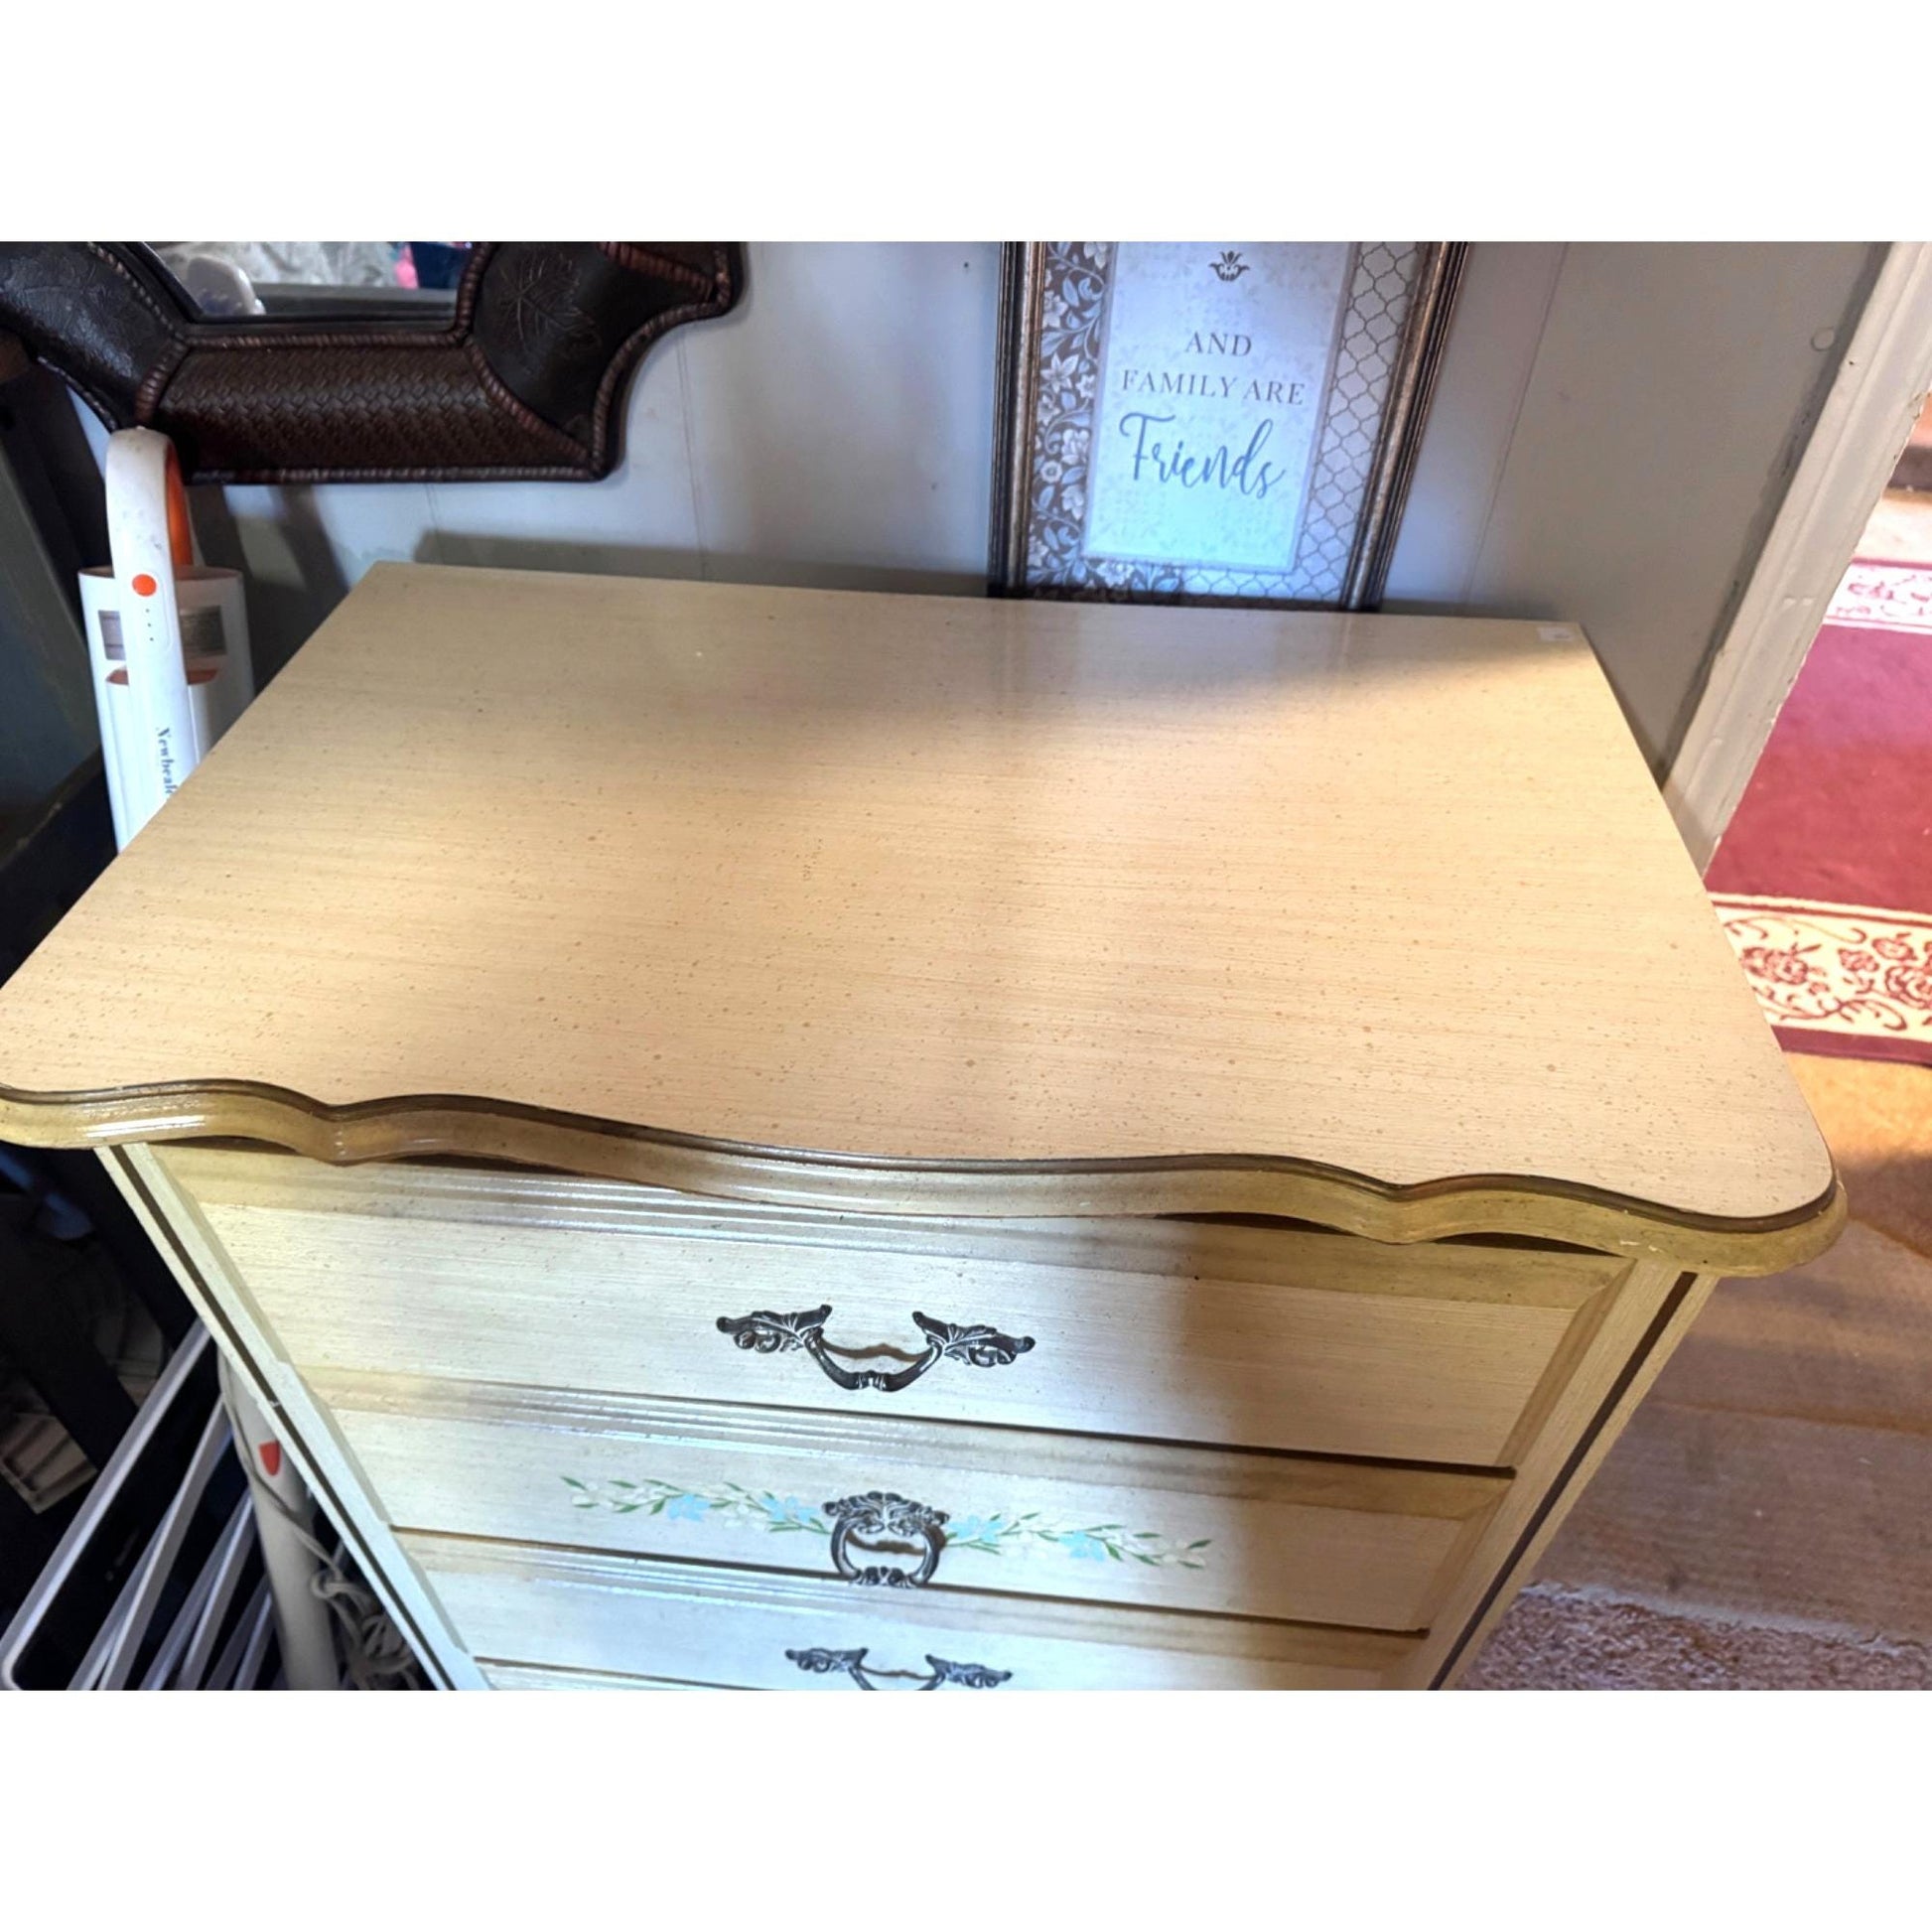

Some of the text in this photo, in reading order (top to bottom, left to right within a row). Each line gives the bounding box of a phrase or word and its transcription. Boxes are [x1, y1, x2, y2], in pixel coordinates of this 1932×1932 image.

[1185, 331, 1253, 357] AND
[1122, 369, 1306, 405] FAMILY ARE
[1119, 412, 1286, 499] Friends
